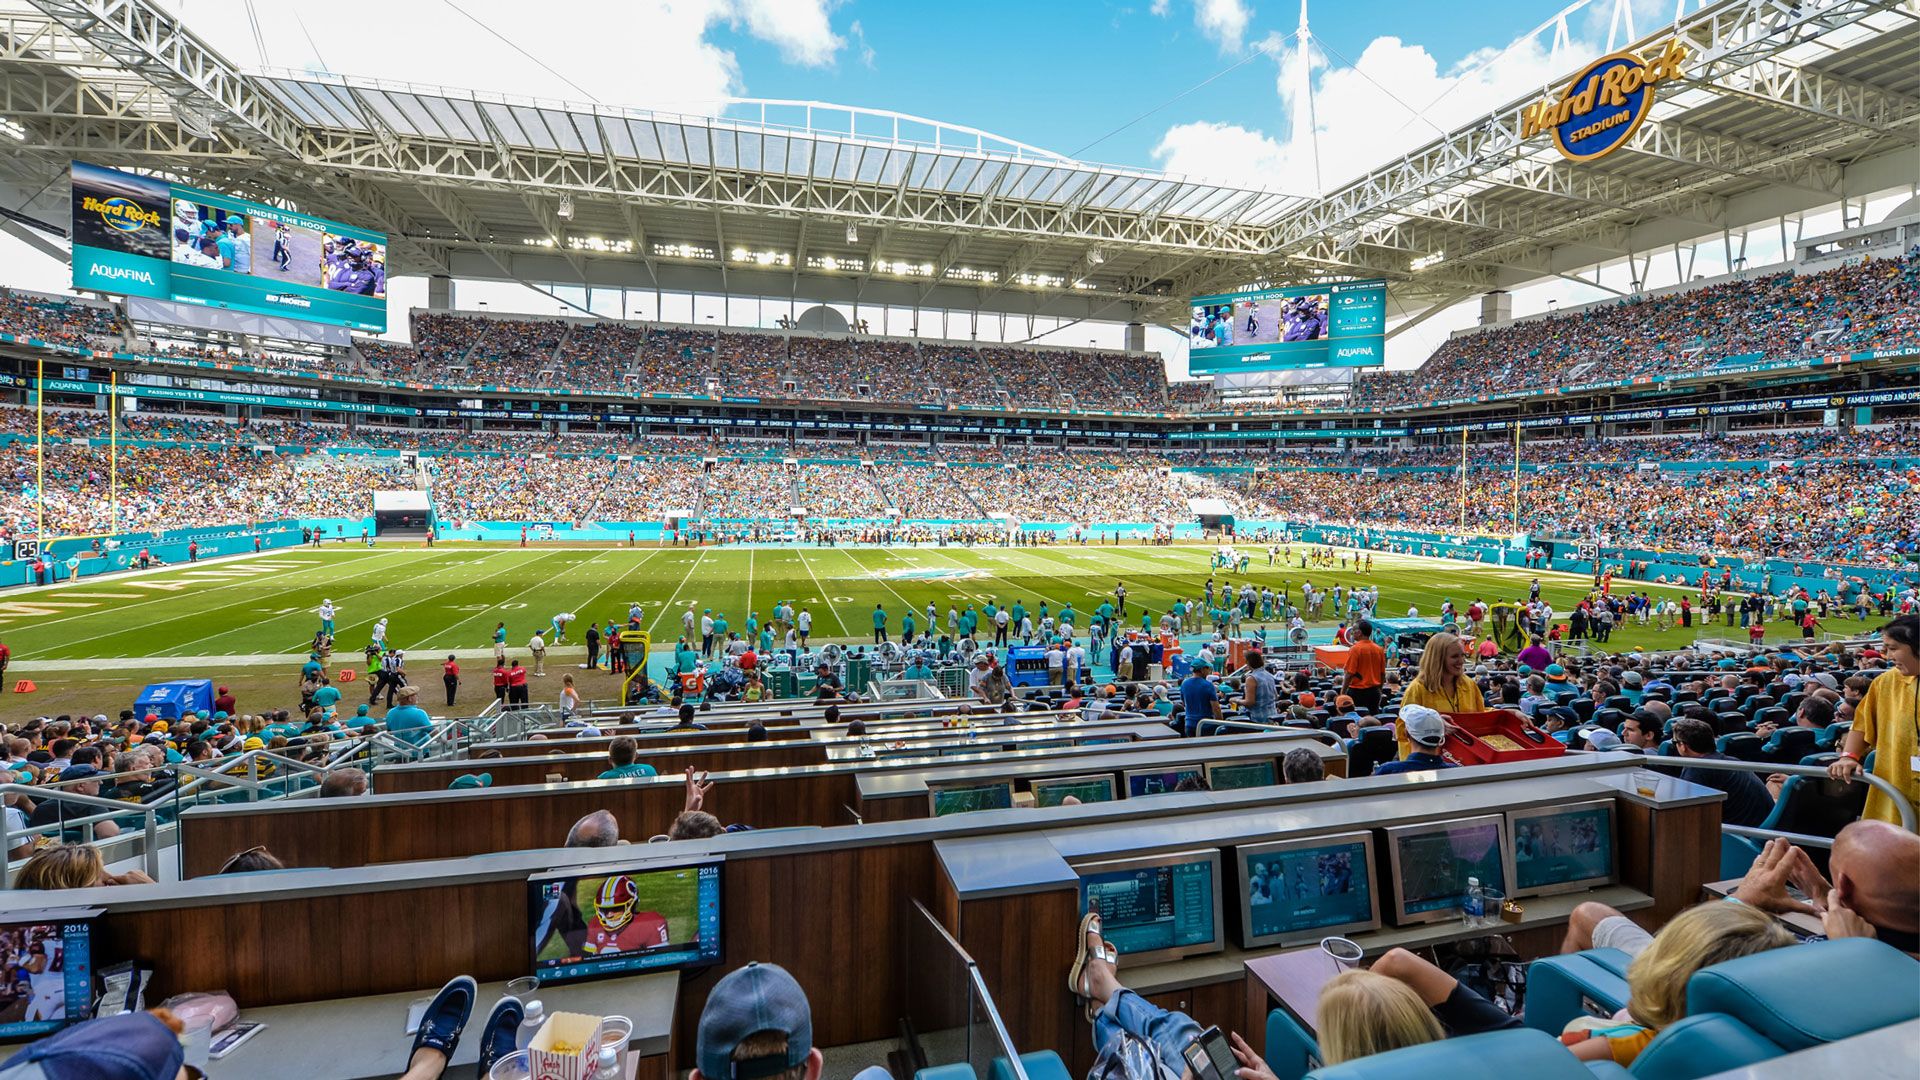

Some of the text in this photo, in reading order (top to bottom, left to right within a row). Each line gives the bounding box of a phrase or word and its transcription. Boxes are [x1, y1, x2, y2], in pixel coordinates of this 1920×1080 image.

[1520, 36, 1688, 139] Hard Rock
[1570, 110, 1630, 143] STADIUM
[82, 196, 160, 226] Hard Rock
[246, 208, 326, 232] UNDER THE HOOD
[90, 263, 155, 285] AQUAFINA
[1337, 346, 1374, 358] AQUAFINA
[50, 382, 85, 391] AQUAFINA
[1847, 396, 1869, 404] FAMILY
[1870, 394, 1892, 402] OWNED
[20, 542, 36, 557] 25
[195, 546, 218, 556] olphins
[1582, 546, 1595, 557] 25
[341, 671, 352, 681] 20
[18, 682, 27, 691] 10
[685, 678, 698, 690] G
[64, 924, 88, 932] 2016
